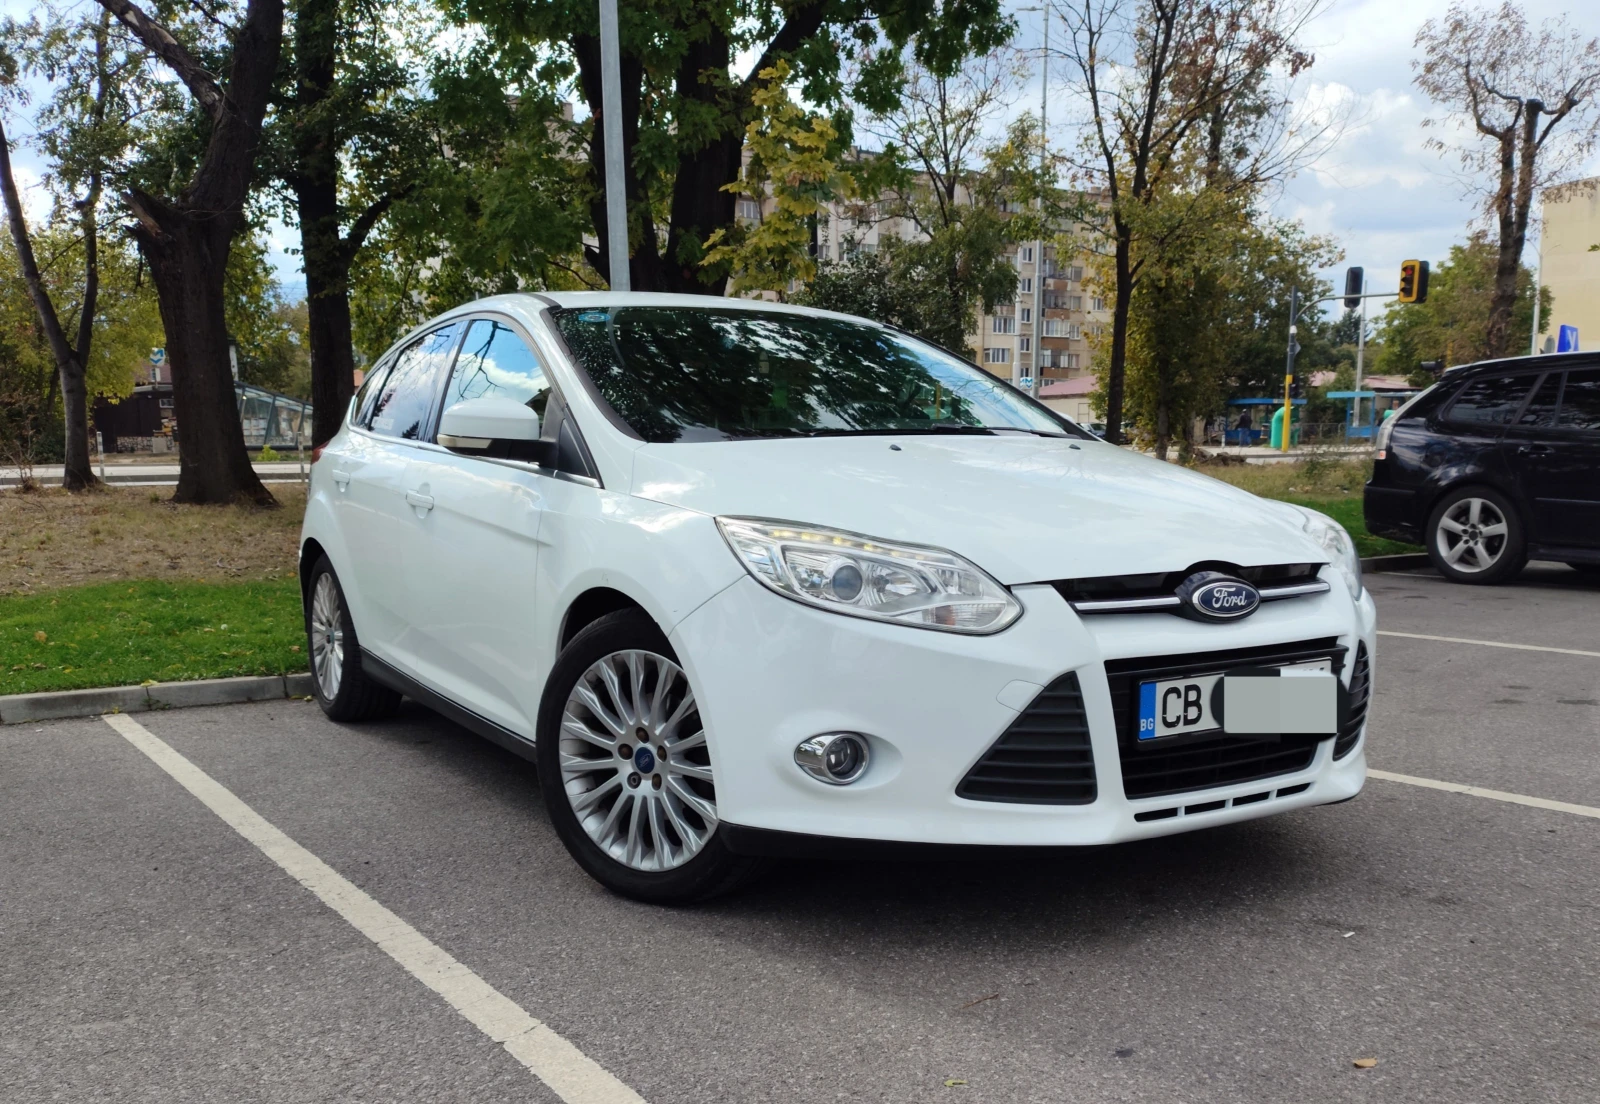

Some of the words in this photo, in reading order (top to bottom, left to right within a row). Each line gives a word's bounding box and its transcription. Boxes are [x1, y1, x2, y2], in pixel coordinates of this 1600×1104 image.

[1212, 587, 1247, 608] Ford
[1162, 684, 1202, 728] CB
[1140, 718, 1154, 731] BG
